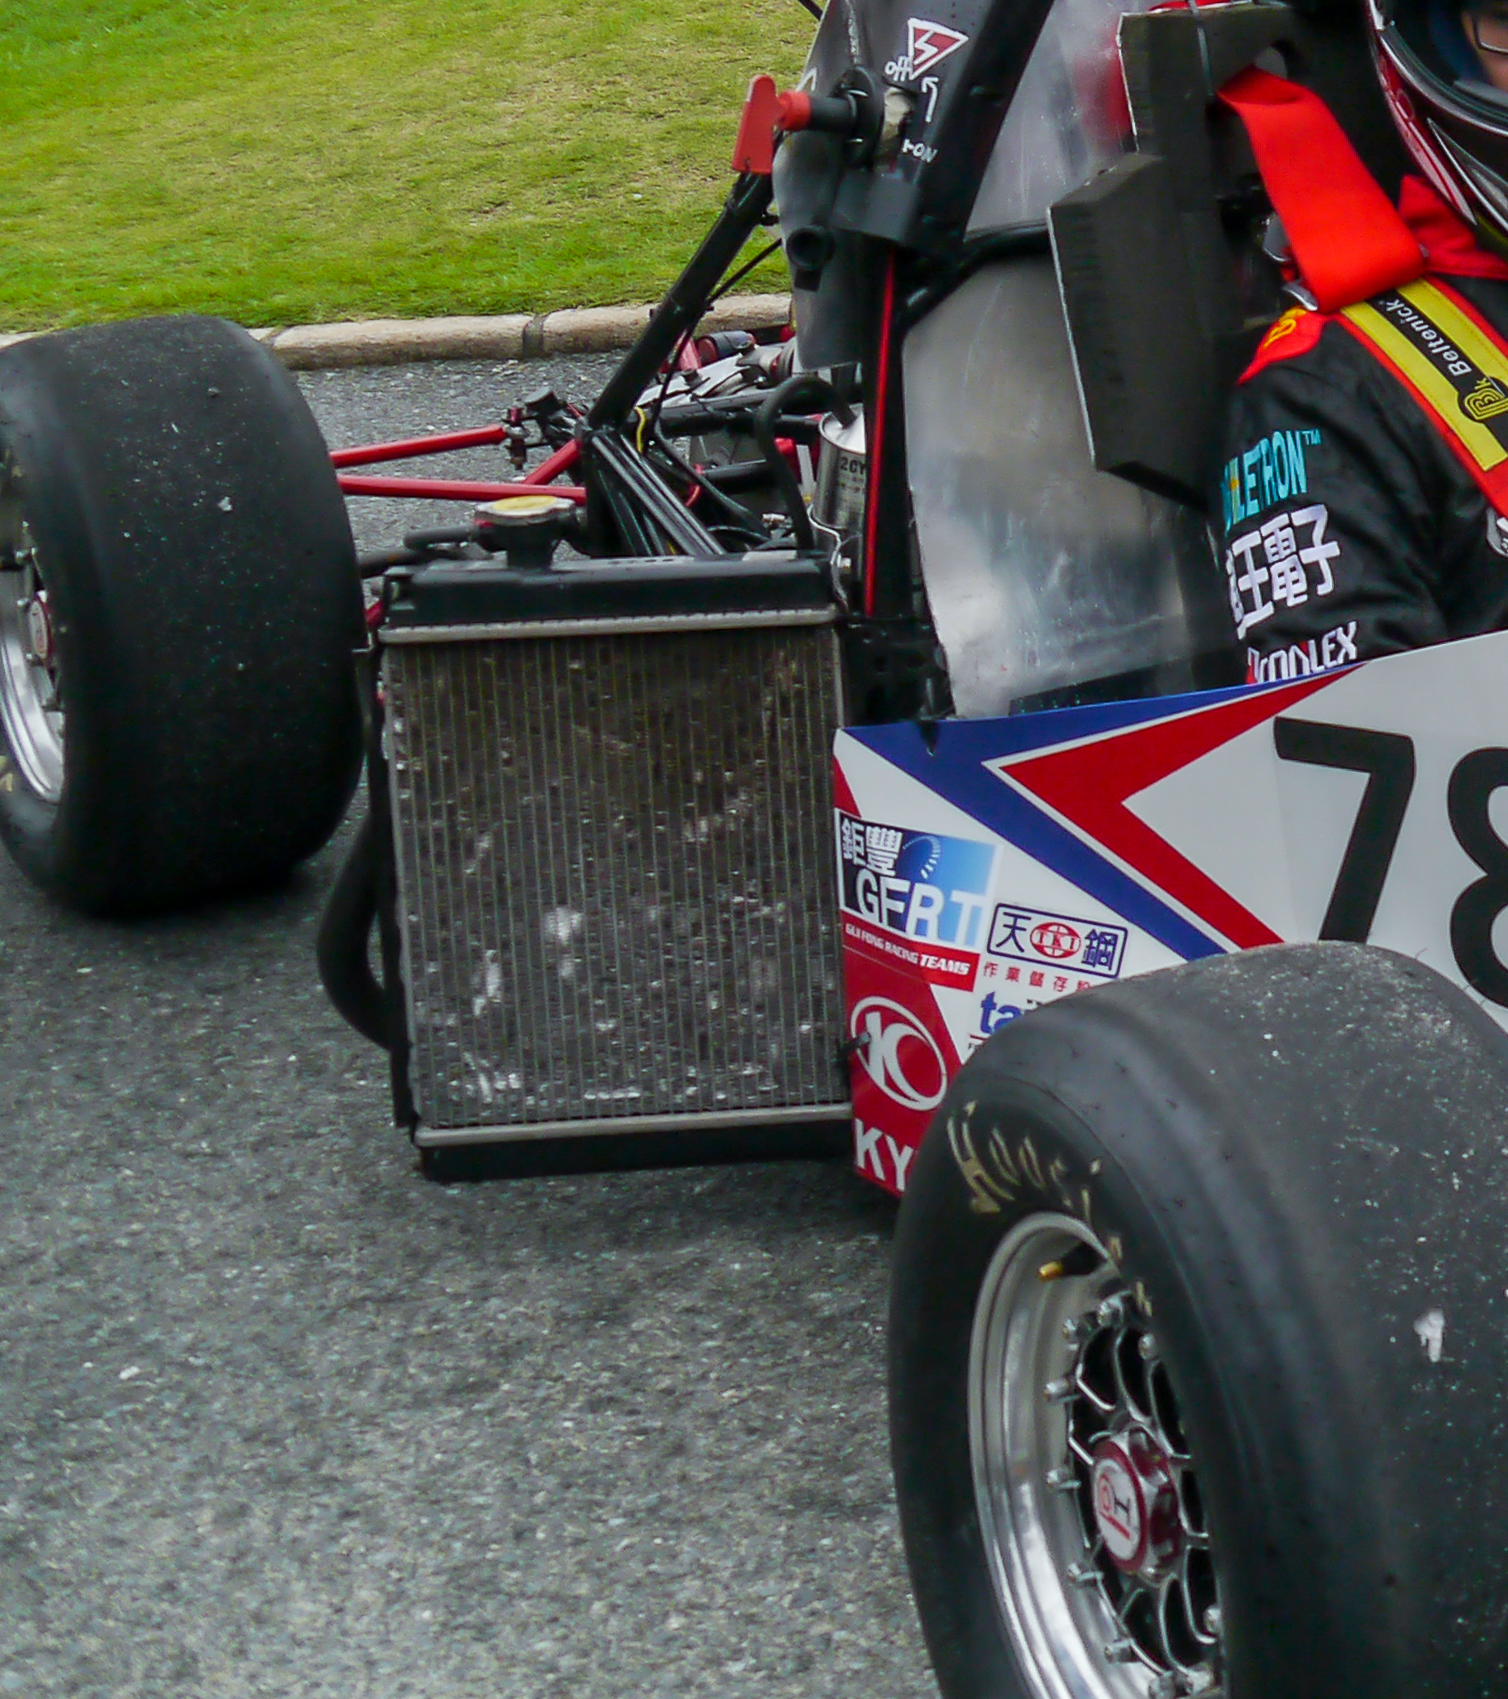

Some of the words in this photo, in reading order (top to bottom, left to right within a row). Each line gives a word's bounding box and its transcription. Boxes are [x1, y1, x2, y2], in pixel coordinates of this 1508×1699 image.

[1386, 299, 1472, 377] Beltenick
[1226, 504, 1340, 640] 王電子
[919, 954, 971, 976] TEAMS
